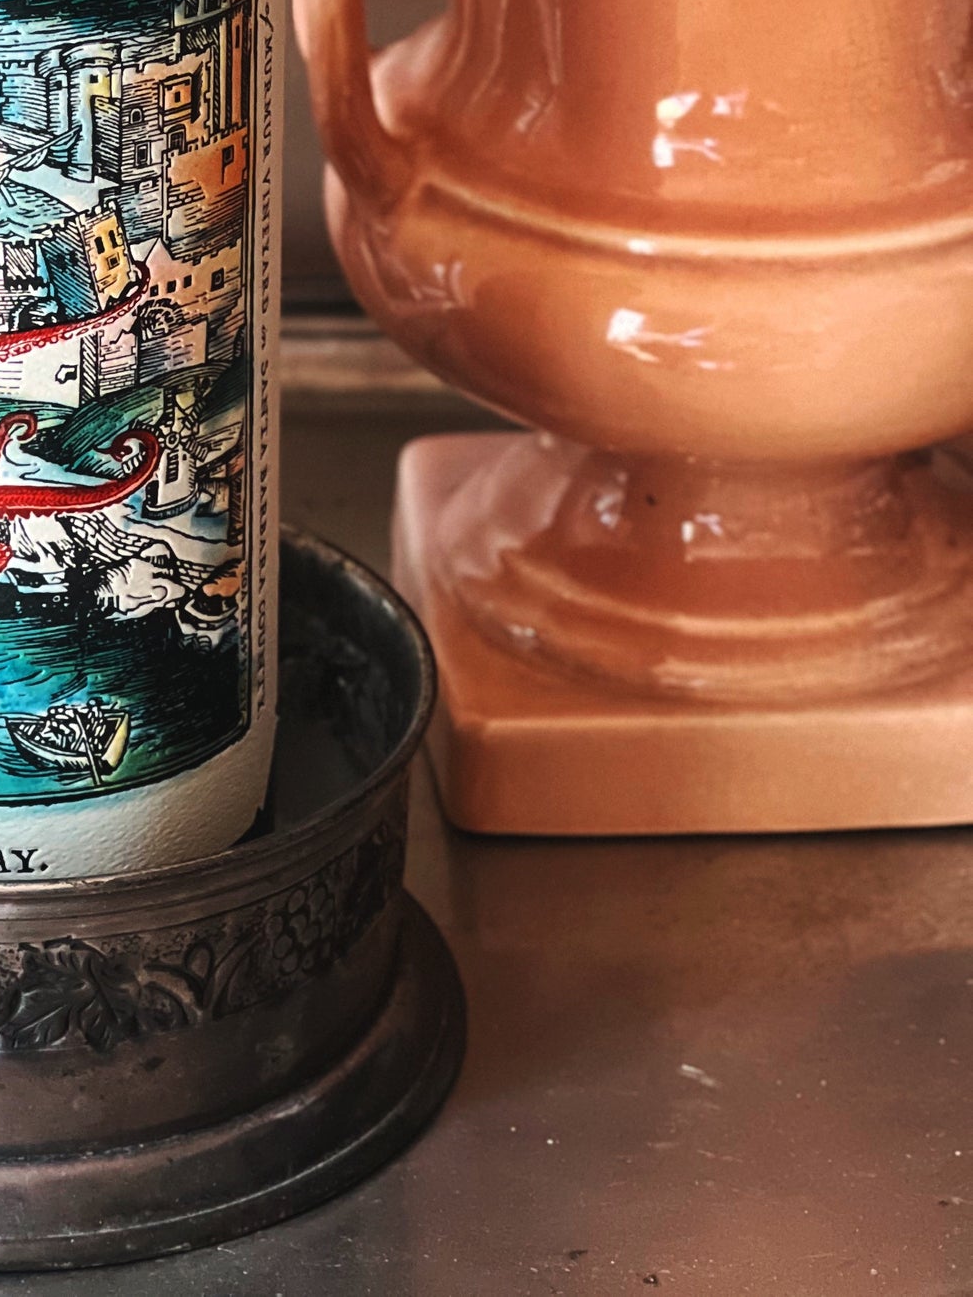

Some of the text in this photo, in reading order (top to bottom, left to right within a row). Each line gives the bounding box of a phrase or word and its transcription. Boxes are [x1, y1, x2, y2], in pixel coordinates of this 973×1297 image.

[259, 2, 274, 33] of
[263, 34, 273, 162] MURMUR
[261, 167, 271, 315] VINEYARD
[260, 359, 269, 460] SANTA
[259, 465, 269, 592] BARBARA
